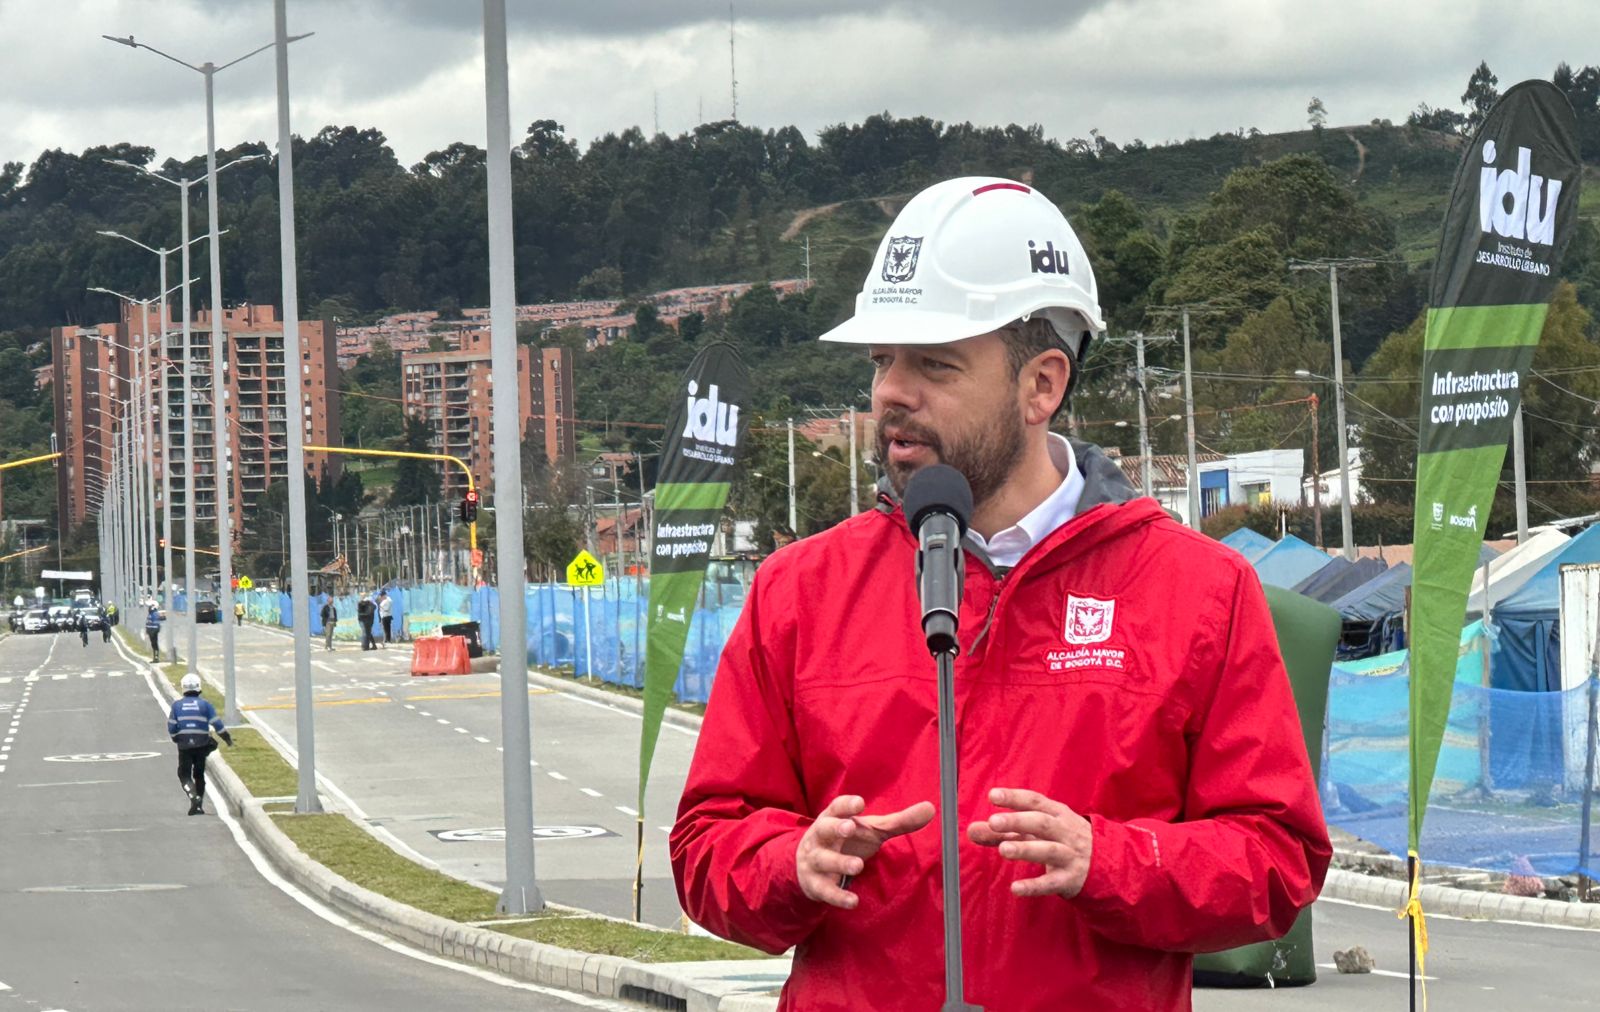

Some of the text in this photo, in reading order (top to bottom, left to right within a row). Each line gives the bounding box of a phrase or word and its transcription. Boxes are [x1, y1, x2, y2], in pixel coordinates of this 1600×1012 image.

[1480, 140, 1563, 246] idu
[1028, 239, 1070, 275] idu
[1476, 250, 1522, 270] DESARROLLO
[898, 287, 923, 296] MAYOR
[1432, 369, 1519, 396] Infraestructura
[682, 379, 740, 448] idu
[1431, 395, 1509, 428] con propósito
[656, 544, 671, 556] con
[1046, 646, 1125, 661] ALCALDÍA MAYOR
[1050, 656, 1124, 670] DE BOGOTÁ D.C.
